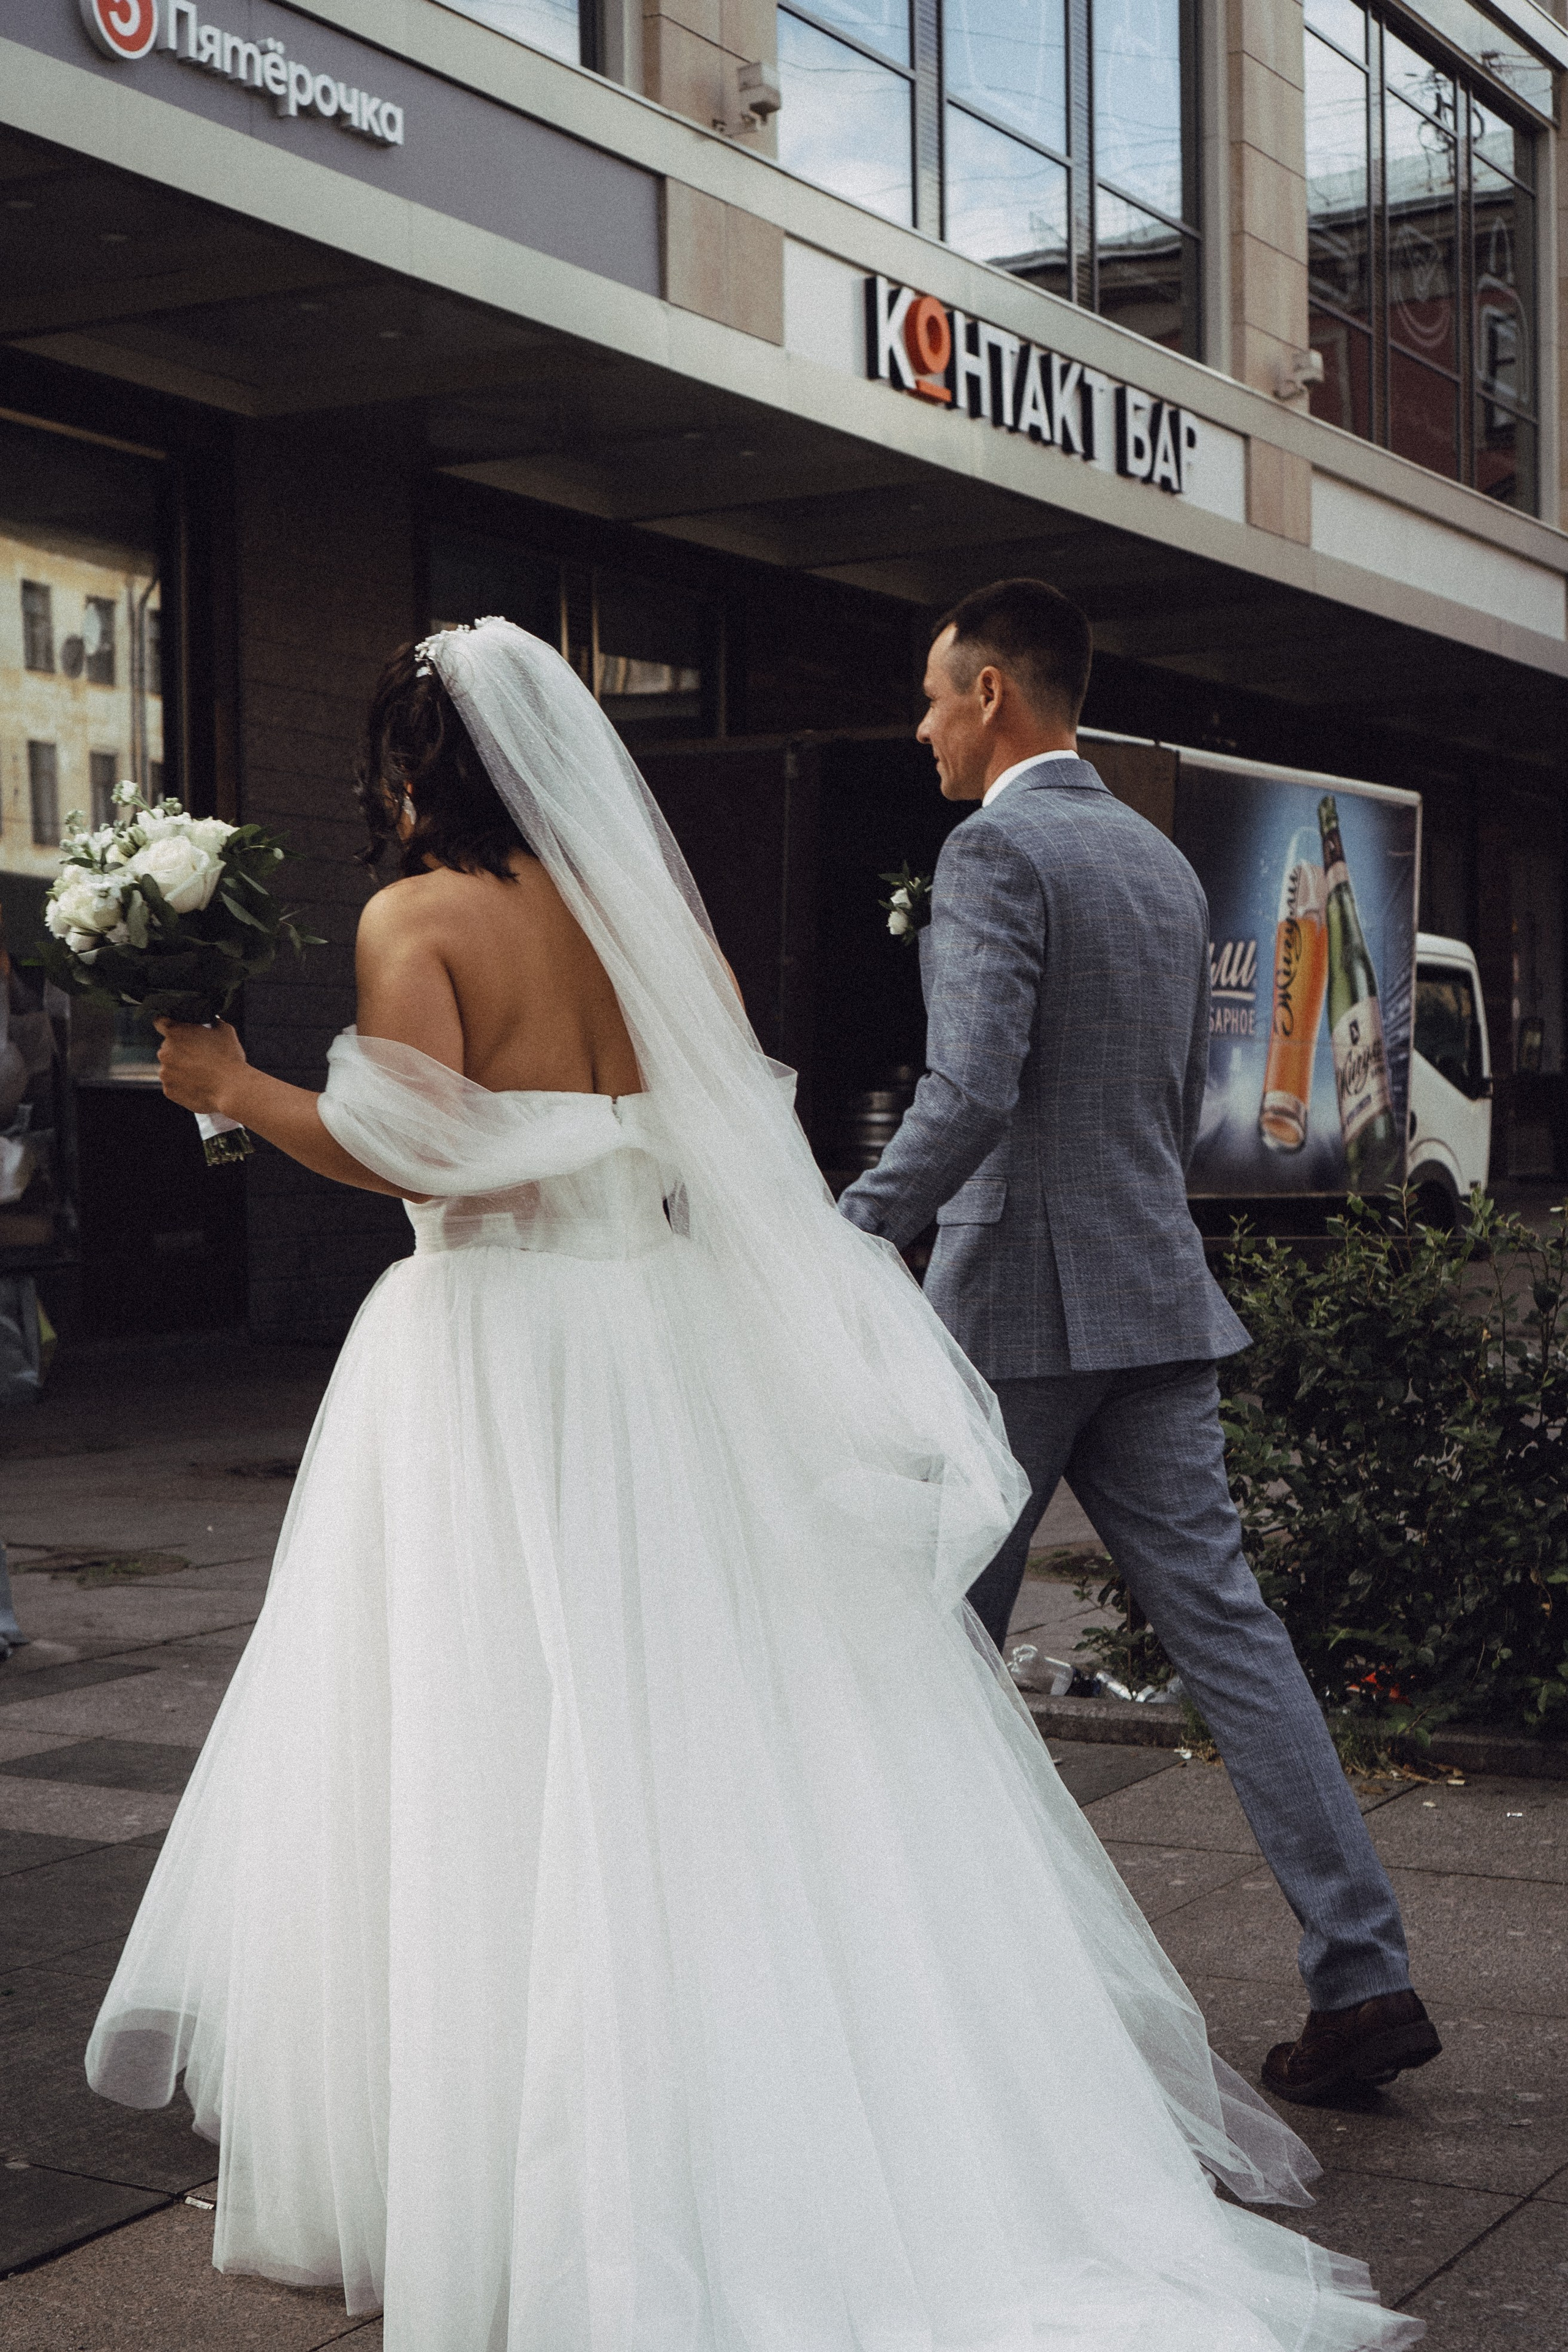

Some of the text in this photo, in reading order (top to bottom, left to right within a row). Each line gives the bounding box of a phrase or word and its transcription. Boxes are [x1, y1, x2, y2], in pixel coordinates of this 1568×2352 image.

[157, 0, 405, 147] Пятёрочка
[864, 274, 1199, 495] КОНТАКТ БАР
